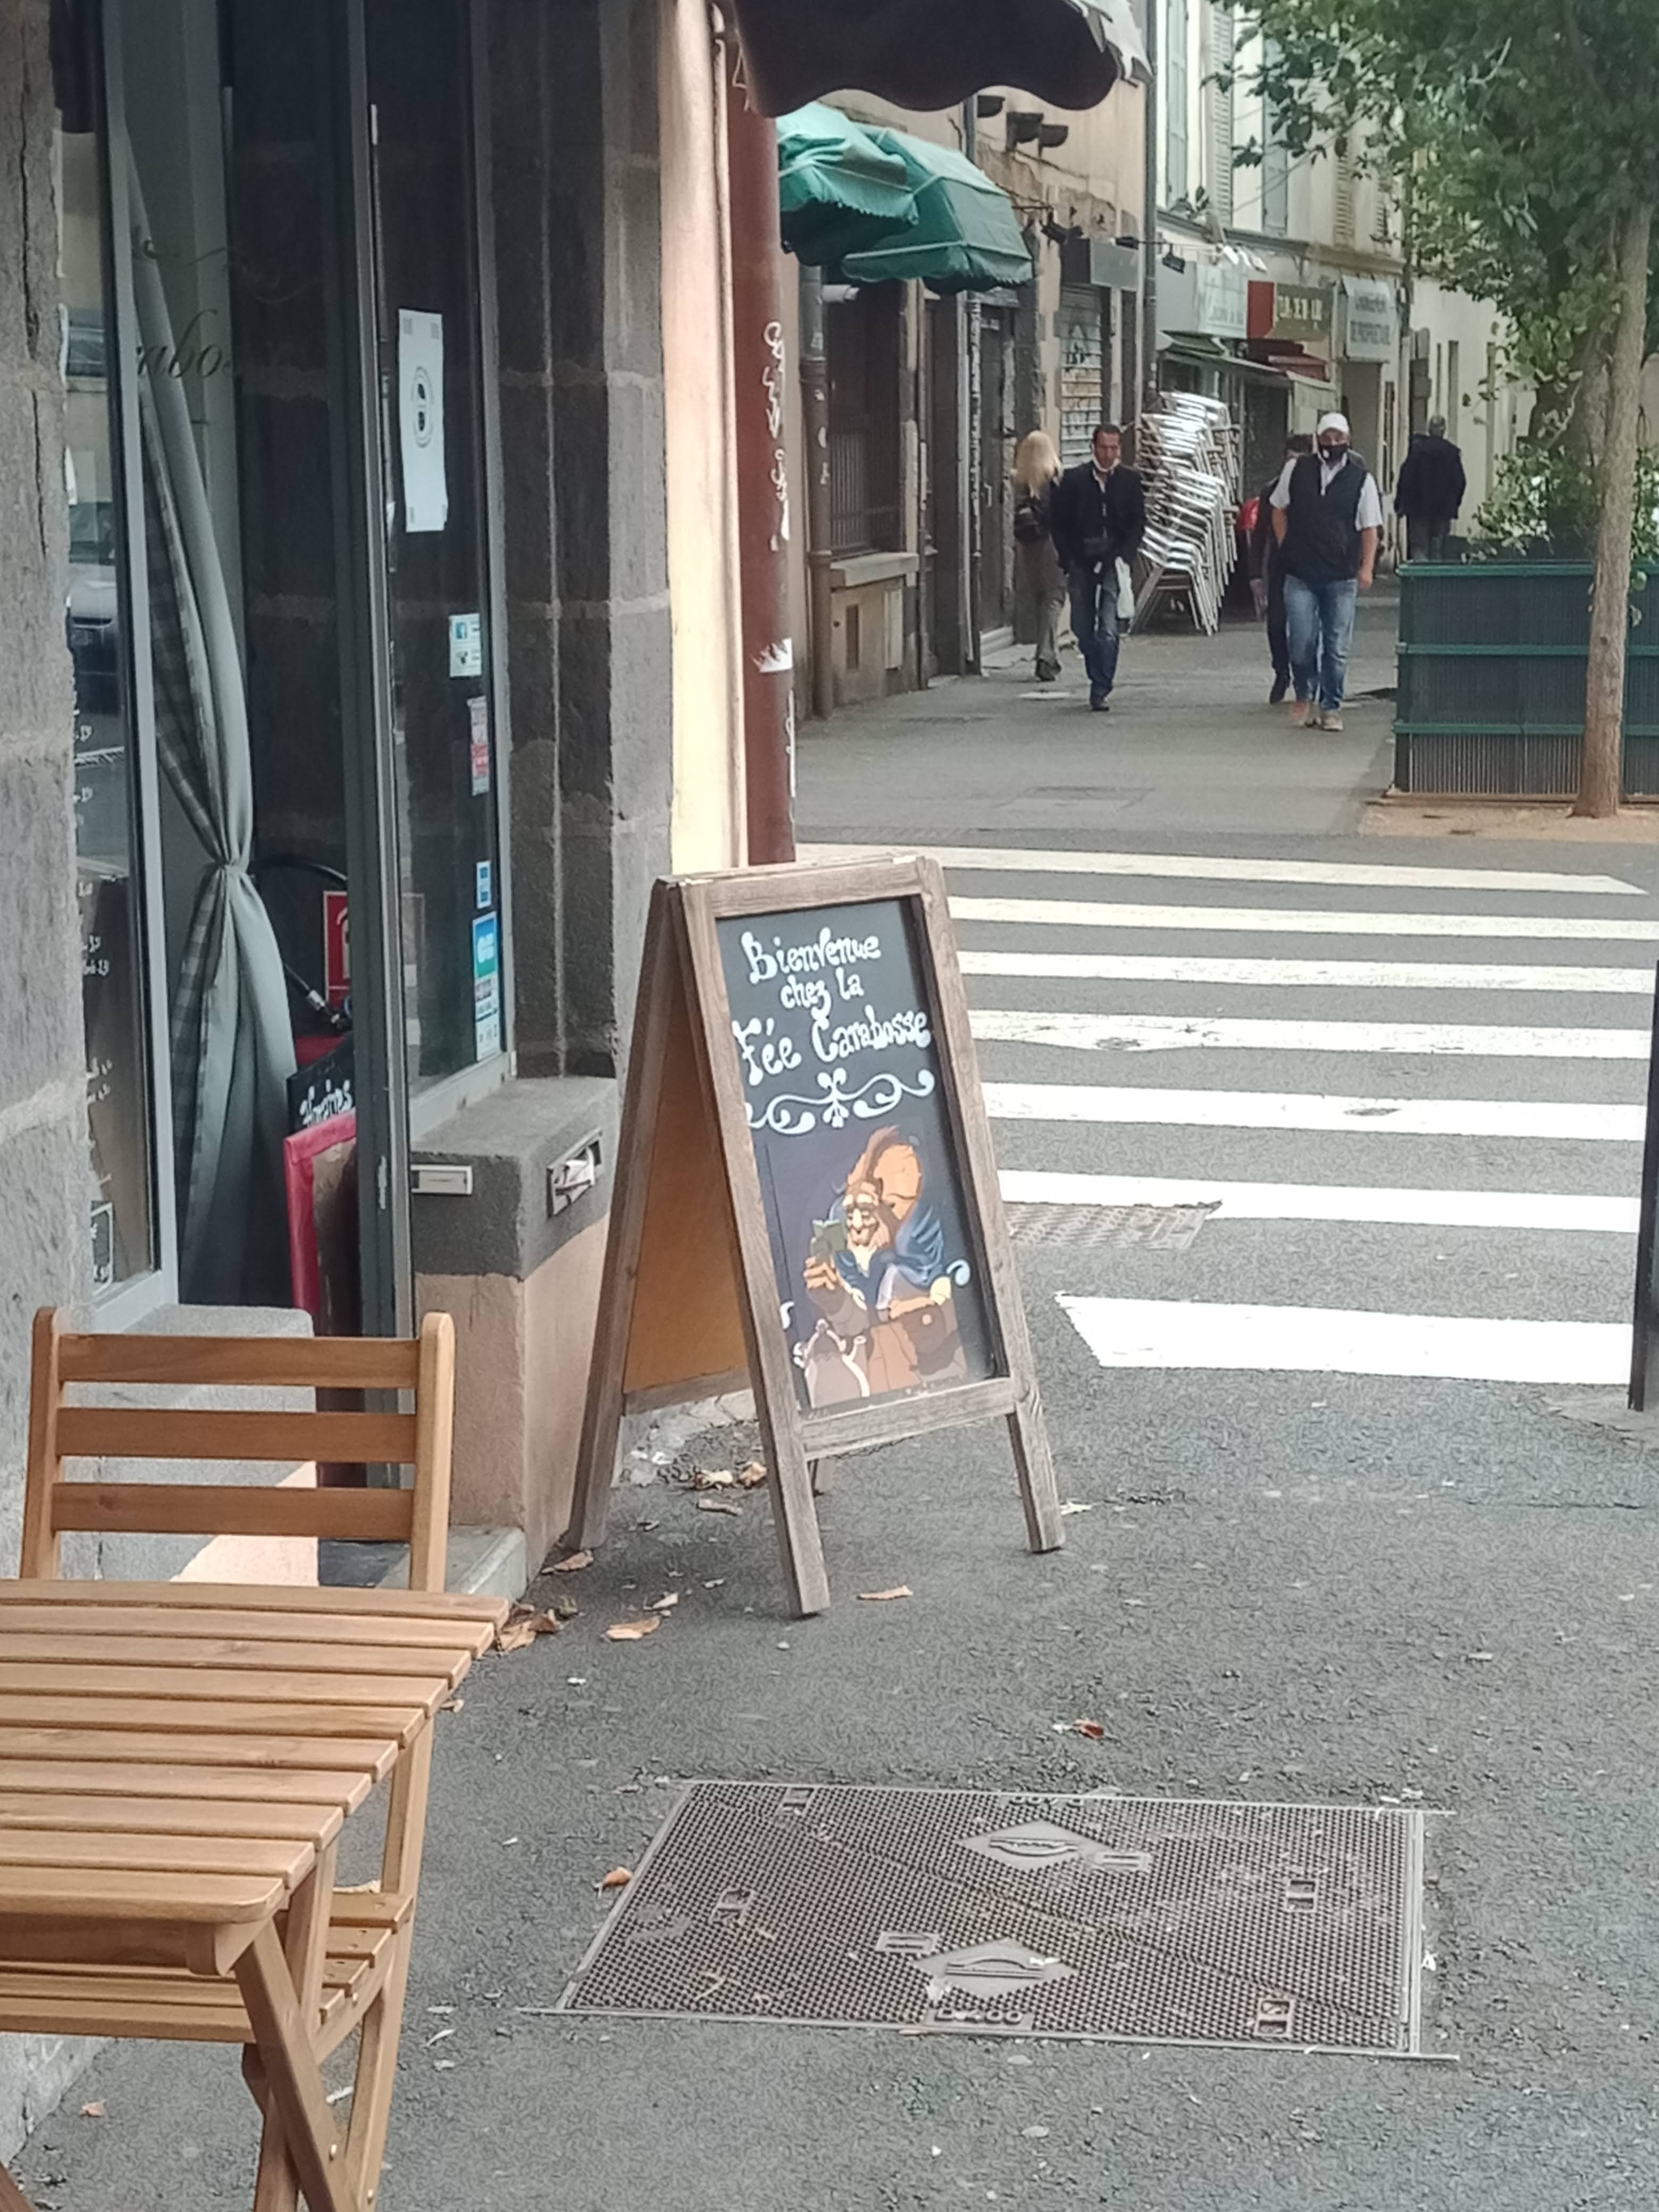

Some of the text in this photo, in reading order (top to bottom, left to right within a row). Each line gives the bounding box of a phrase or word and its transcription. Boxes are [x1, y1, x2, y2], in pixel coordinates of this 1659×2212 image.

[741, 927, 882, 984] Bienvenue
[780, 967, 864, 1021] chez la
[811, 1004, 932, 1063] Carabosse
